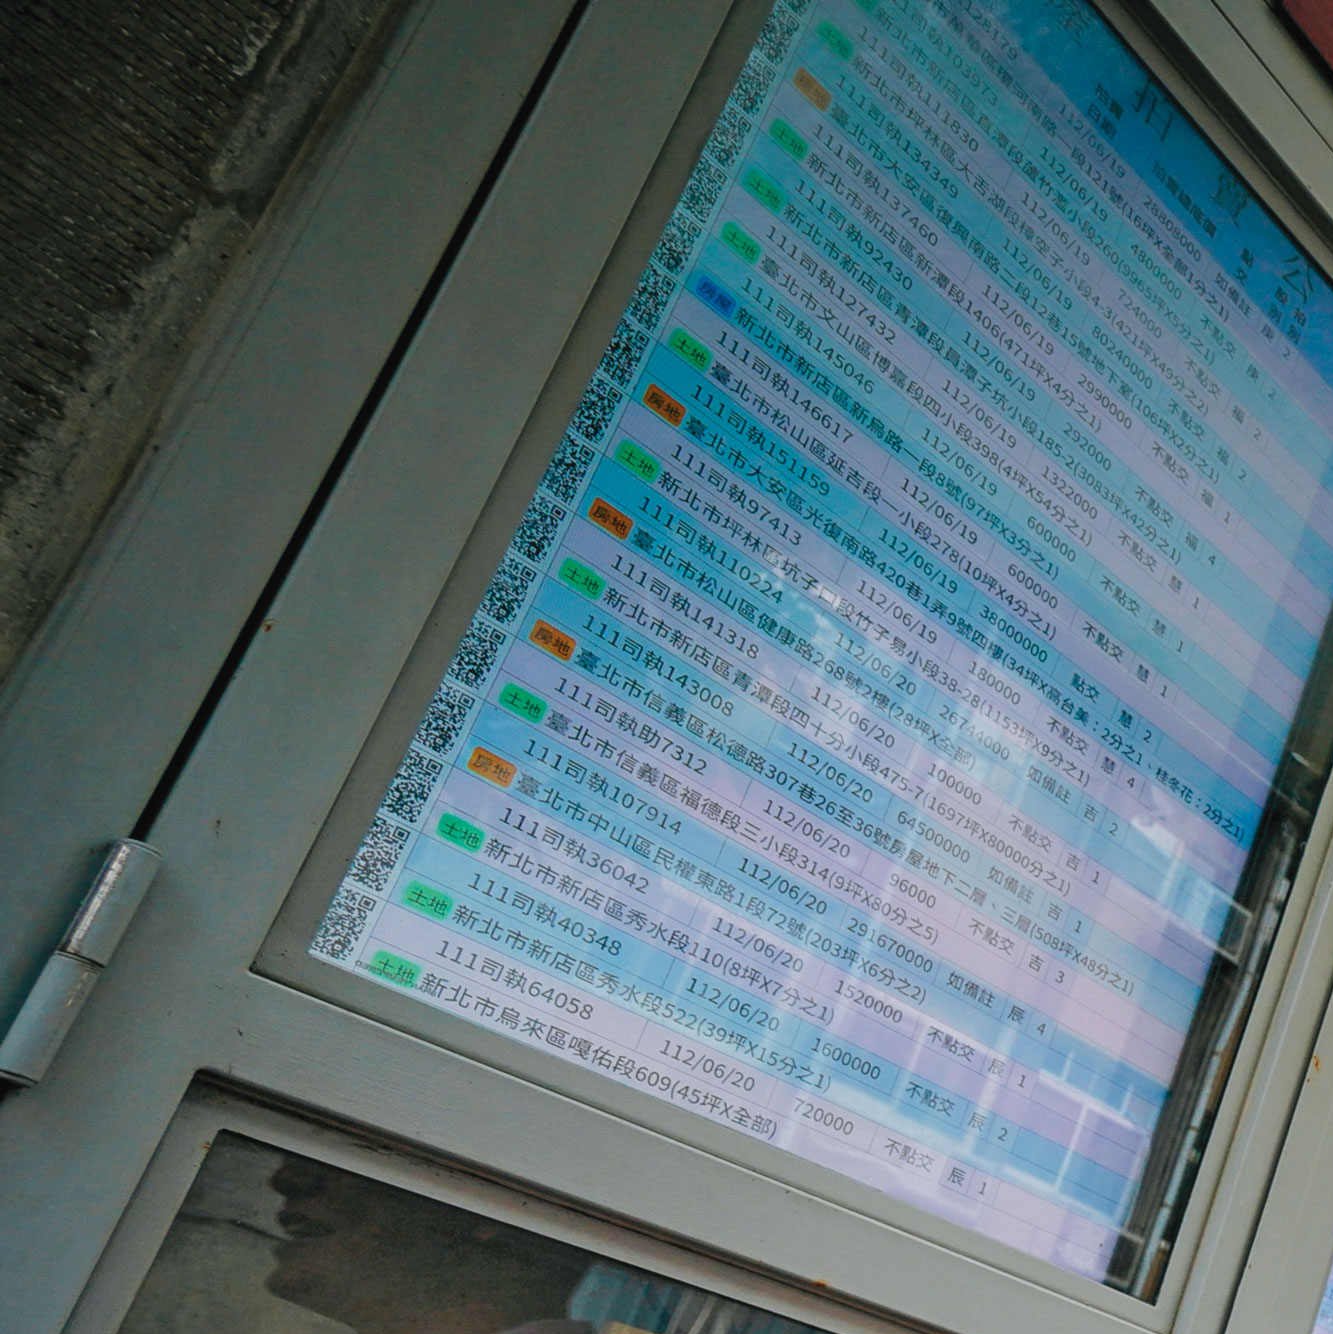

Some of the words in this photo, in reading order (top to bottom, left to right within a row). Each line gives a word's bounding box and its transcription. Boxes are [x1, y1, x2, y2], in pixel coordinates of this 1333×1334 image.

[811, 120, 940, 250] 111司執137460
[981, 281, 1056, 359] 112/06/19
[1076, 371, 1133, 432] 2990000
[1149, 438, 1191, 486] 不點交
[834, 71, 960, 204] 111司執134349
[1001, 236, 1073, 314] 112/06/19
[1090, 323, 1154, 392] 80240000
[856, 24, 980, 157] 111司執111830
[1020, 189, 1091, 269] 112/06/19
[1116, 287, 1163, 342] 724000
[1039, 144, 1109, 225] 112/06/19
[1129, 239, 1183, 302] 4800000
[646, 385, 684, 422] 房地
[739, 273, 877, 398] 111司執145046
[920, 425, 999, 499] 112/06/19
[1025, 513, 1078, 564] 600000
[1098, 572, 1142, 618] 不點交
[765, 220, 899, 347] 111司執127432
[941, 376, 1018, 452] 112/06/19
[1040, 463, 1099, 522] 1322000
[1115, 526, 1159, 574] 不點交
[793, 174, 915, 294] 111司執92430
[961, 328, 1037, 405] 112/06/19
[1062, 420, 1113, 473] 292000
[1133, 482, 1175, 529] 不點交
[562, 561, 602, 597] 土地
[591, 502, 630, 538] 房地
[669, 439, 804, 550] 111司執97413
[855, 577, 939, 647] 112/06/19
[967, 658, 1022, 707] 180000
[1044, 712, 1090, 757] 不點交
[689, 380, 833, 500] 111司執151159
[877, 525, 960, 597] 112/06/19
[978, 602, 1049, 665] 38000000
[1069, 670, 1101, 705] 點交
[715, 325, 855, 448] 111司執146617
[899, 474, 980, 548] 112/06/19
[1005, 560, 1059, 611] 600000
[1080, 618, 1126, 664] 不點交
[471, 750, 514, 785] 房地
[503, 685, 545, 720] 土地
[533, 622, 574, 657] 房地
[580, 610, 737, 721] 111司執143008
[786, 739, 875, 805] 112/06/20
[895, 808, 972, 865] 64500000
[986, 862, 1036, 905] 如備註
[608, 550, 762, 664] 111司執141318
[810, 684, 897, 751] 112/06/20
[926, 761, 983, 808] 100000
[1006, 811, 1054, 855] 不點交
[636, 491, 787, 608] 111司執110224
[833, 629, 918, 698] 112/06/20
[938, 702, 1011, 762] 26744000
[1026, 761, 1073, 805] 如備註
[407, 884, 452, 918] 土地
[439, 817, 483, 851] 土地
[497, 802, 652, 898] 111司執36042
[710, 915, 805, 976] 112/06/20
[833, 978, 905, 1025] 1520000
[924, 1023, 977, 1063] 不點交
[521, 735, 685, 840] 111司執107914
[736, 855, 829, 917] 112/06/20
[846, 915, 935, 975] 291670000
[945, 968, 997, 1010] 如備註
[761, 796, 852, 861] 112/06/20
[887, 870, 938, 910] 96000
[966, 915, 1016, 957] 不點交
[374, 952, 421, 986] 土地
[433, 935, 597, 1024] 111司執64058
[658, 1036, 758, 1094] 112/06/20
[791, 1097, 855, 1137] 720000
[881, 1134, 936, 1173] 不點交
[465, 868, 625, 961] 111司執40348
[684, 975, 781, 1034] 112/06/20
[810, 1035, 882, 1082] 1600000
[903, 1079, 956, 1118] 不點交
